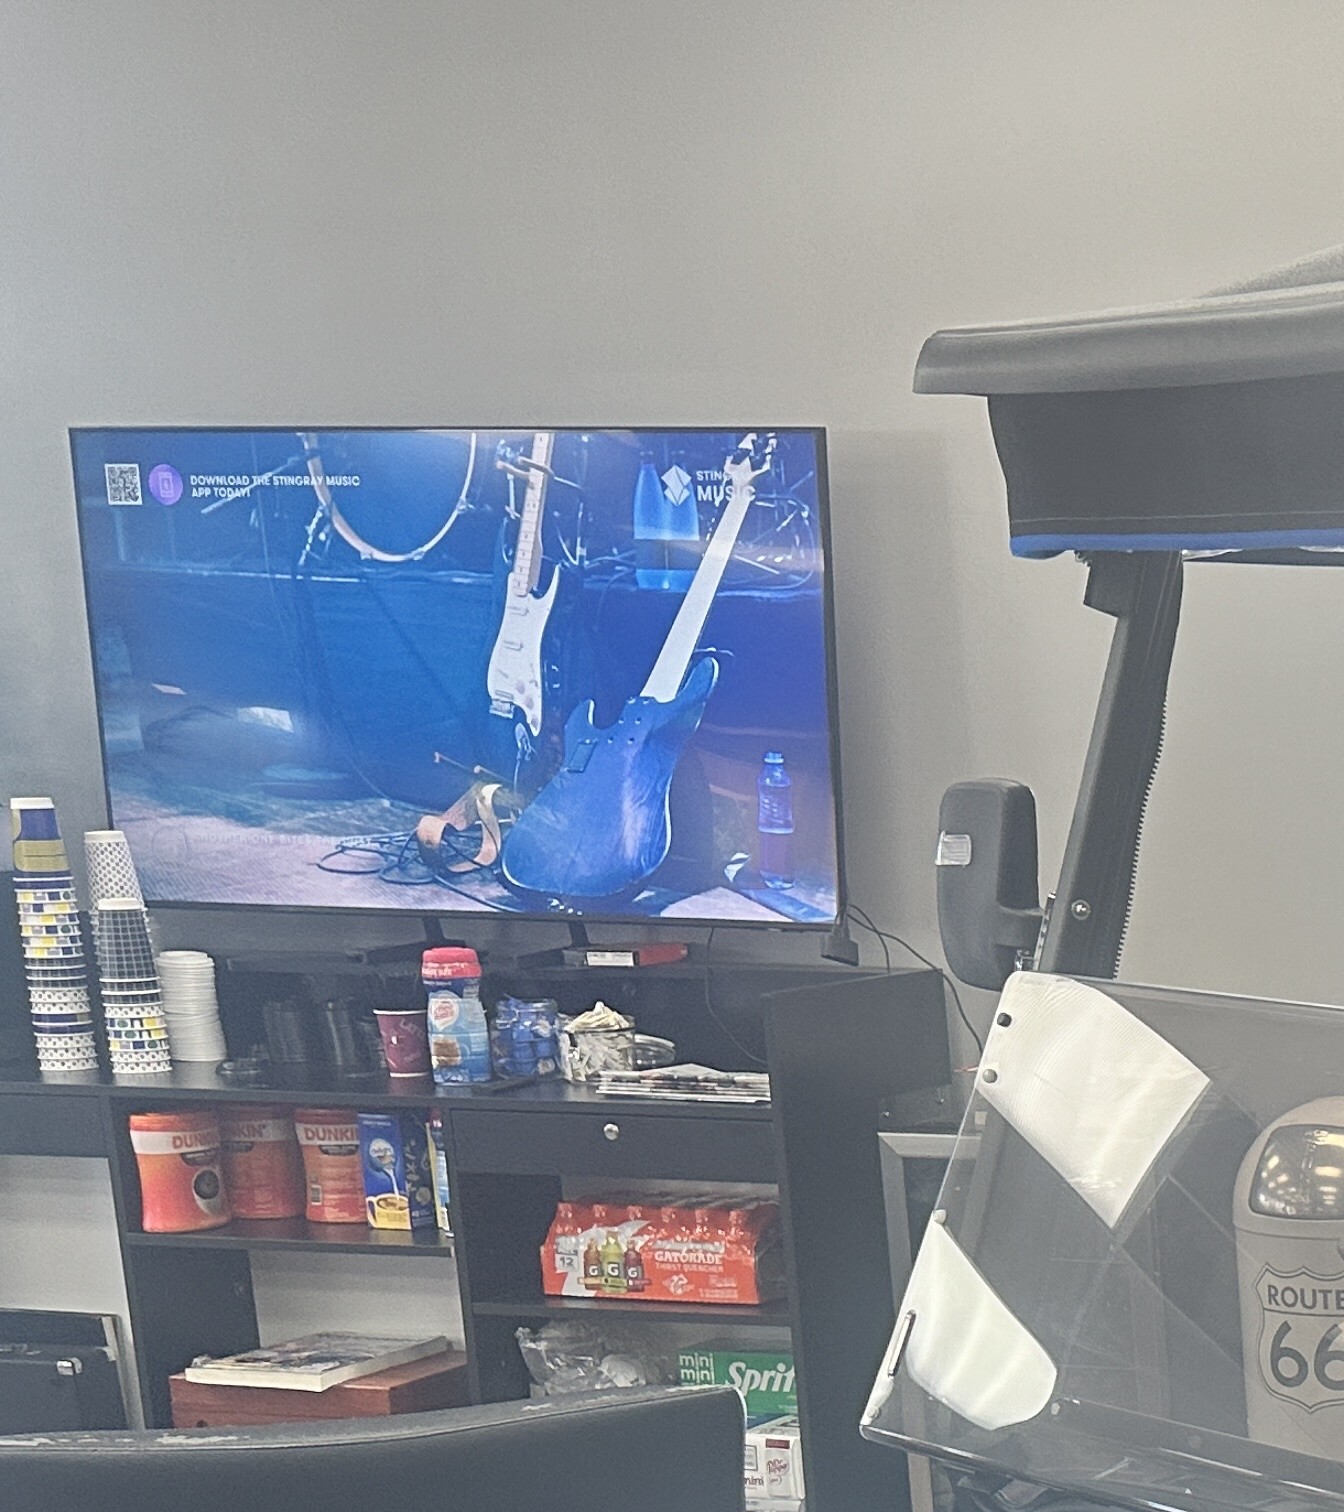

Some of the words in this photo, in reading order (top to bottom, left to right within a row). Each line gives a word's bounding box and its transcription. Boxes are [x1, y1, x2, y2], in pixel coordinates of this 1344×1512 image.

[190, 475, 250, 486] DOWNLOAD
[251, 475, 271, 486] THE
[273, 475, 323, 487] STINGRAY
[325, 475, 361, 487] MUSIC
[192, 487, 212, 498] APP
[654, 1249, 724, 1265] GATORADE
[588, 1265, 599, 1276] G
[607, 1263, 619, 1276] G
[627, 1266, 638, 1278] G
[680, 1352, 715, 1369] mini
[728, 1361, 796, 1397] Sprit
